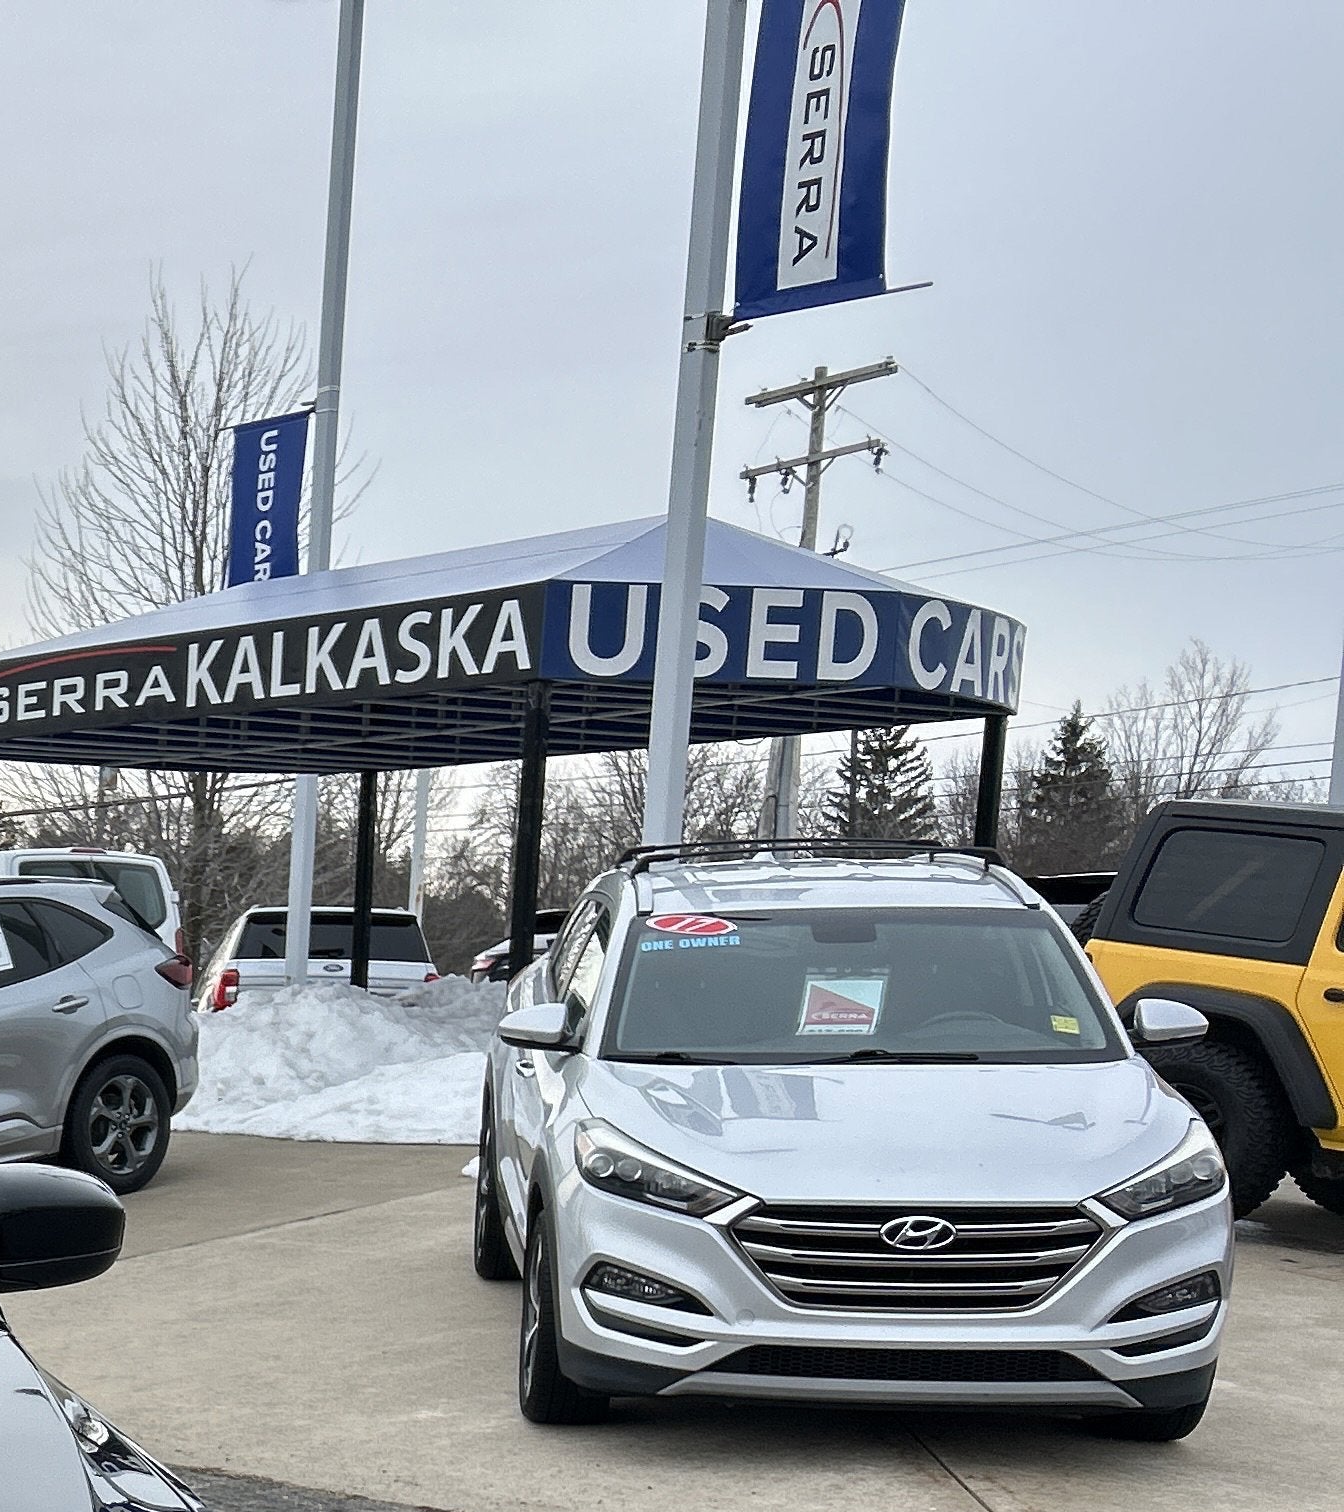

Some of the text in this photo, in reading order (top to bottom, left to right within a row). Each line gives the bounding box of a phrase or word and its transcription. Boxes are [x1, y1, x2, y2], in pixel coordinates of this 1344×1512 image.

[792, 45, 835, 266] SERRA
[256, 430, 279, 511] USED
[186, 600, 531, 707] KALKASKA
[569, 584, 878, 681] USED
[909, 600, 1026, 709] CARS
[641, 936, 740, 951] ONE OWNER
